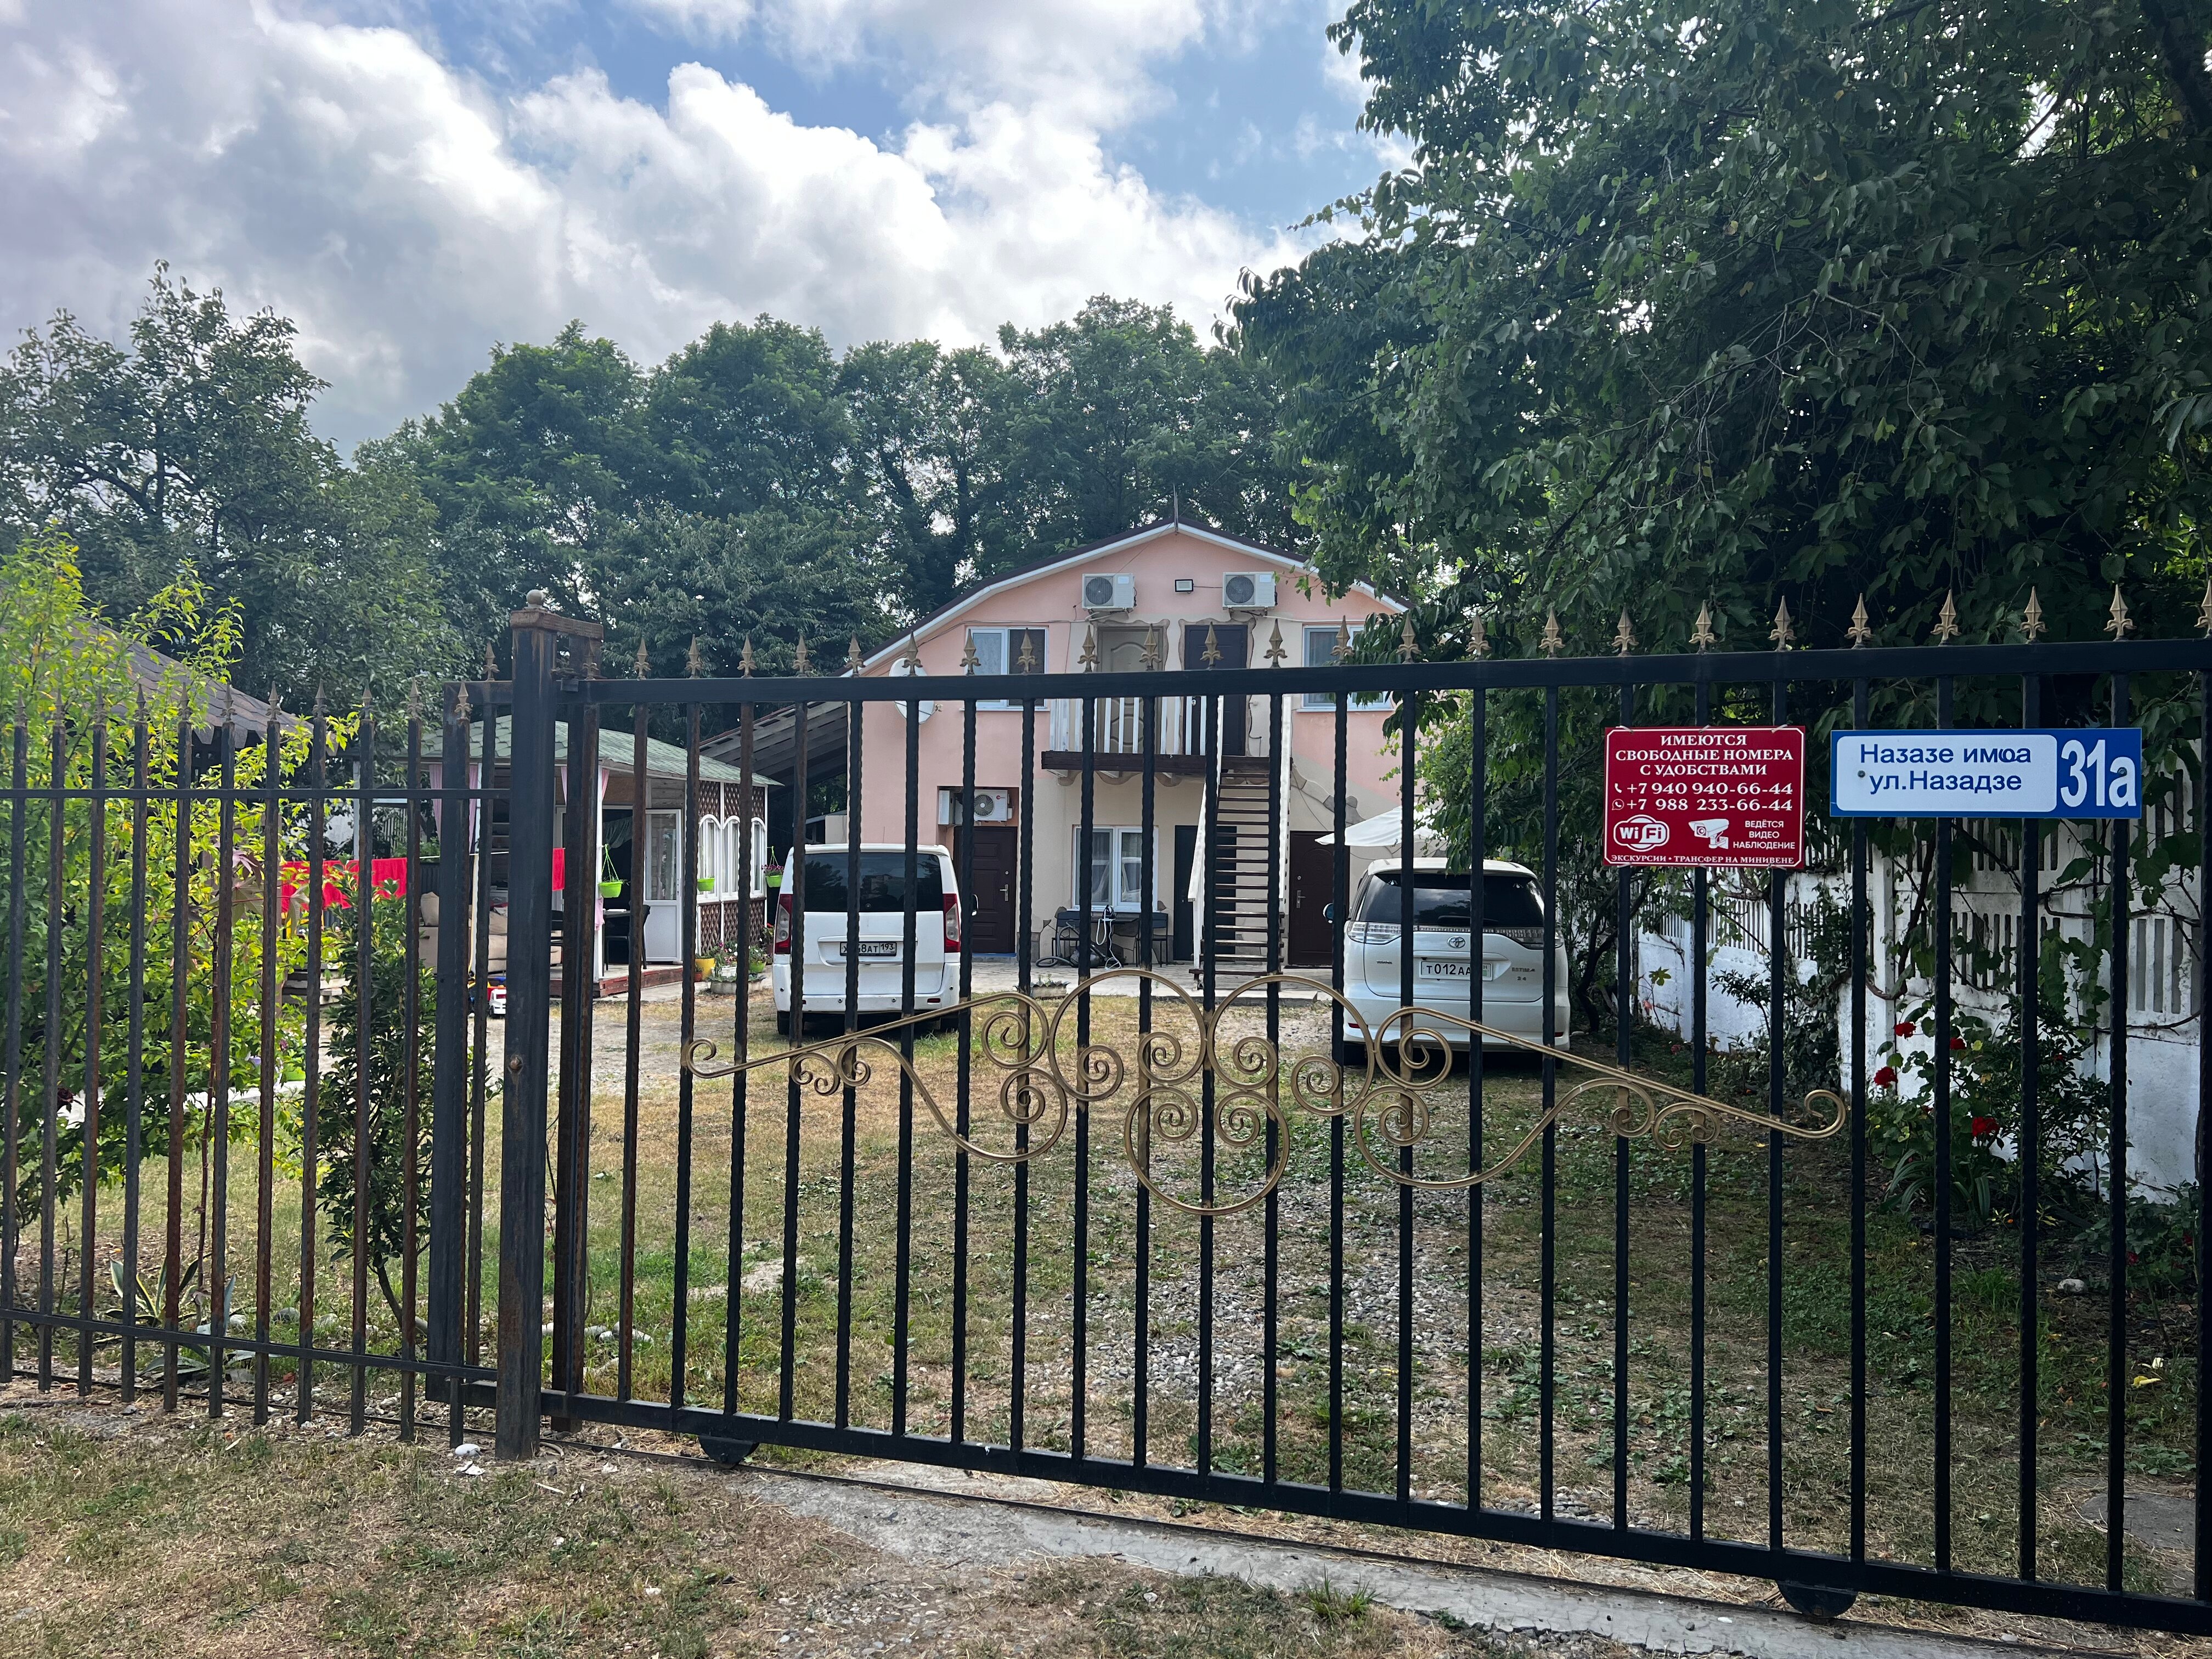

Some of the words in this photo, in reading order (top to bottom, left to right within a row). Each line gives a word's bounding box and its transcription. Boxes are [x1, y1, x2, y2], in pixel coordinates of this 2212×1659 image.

[1660, 735, 1747, 746] ИМЕЮТСЯ
[1615, 749, 1720, 763] СВОБОДНЫЕ
[1723, 749, 1794, 761] НОМЕРА
[1640, 764, 1651, 775] С
[1654, 764, 1767, 777] УДОБСТВАМИ
[1627, 782, 1647, 794] +7
[1651, 782, 1688, 794] 940
[1691, 782, 1793, 795] 940-66-44
[1869, 770, 2022, 795] ул.Назадзе
[1626, 798, 1647, 810] +7
[1655, 798, 1689, 811] 988
[1696, 799, 1793, 811] 233-66-44
[1745, 819, 1784, 829] ВЕДЁТСЯ
[1748, 831, 1780, 839] ВИДЕО
[1733, 841, 1796, 850] НАБЛЮДЕНИЕ
[1611, 854, 1667, 862] ЭКСКУРСИИ
[1673, 855, 1724, 864] ТРАНСФЕР
[1740, 856, 1795, 865] МИНИВЕНЕ
